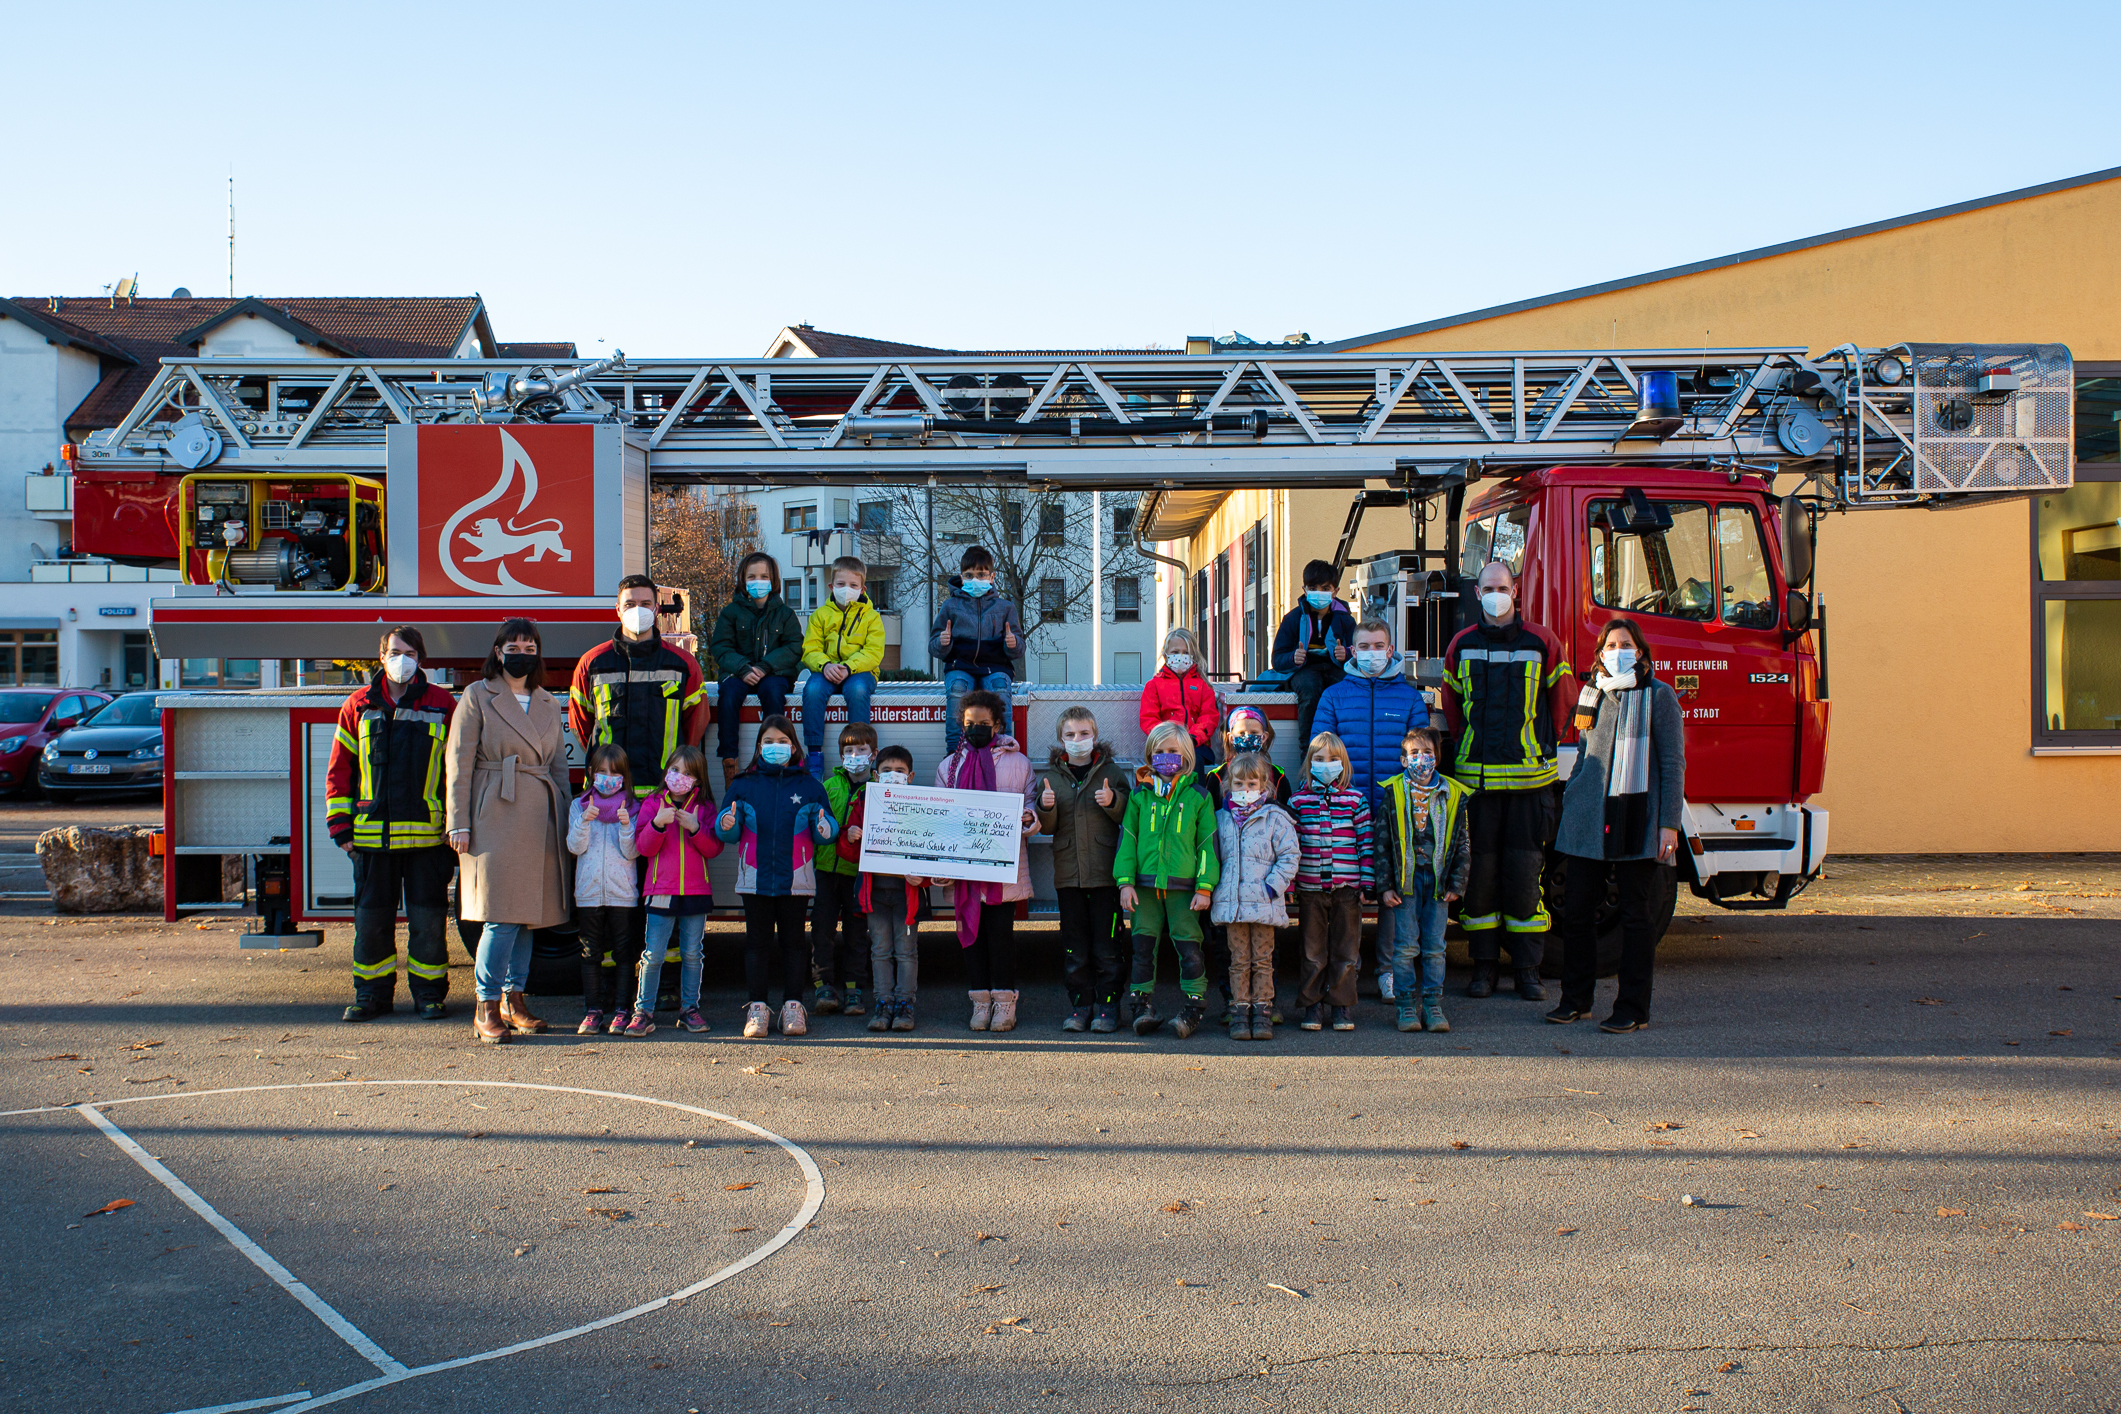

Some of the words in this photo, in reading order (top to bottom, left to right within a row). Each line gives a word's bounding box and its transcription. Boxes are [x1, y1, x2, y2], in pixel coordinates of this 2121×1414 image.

[92, 450, 111, 458] 30m
[1676, 660, 1728, 671] FEUERWEHR
[1750, 673, 1789, 683] 1524
[1693, 708, 1720, 719] STADT
[930, 796, 955, 804] Böblingen
[888, 804, 950, 816] ACHTHUNDERT
[992, 821, 1015, 831] Stadt
[922, 829, 936, 838] der
